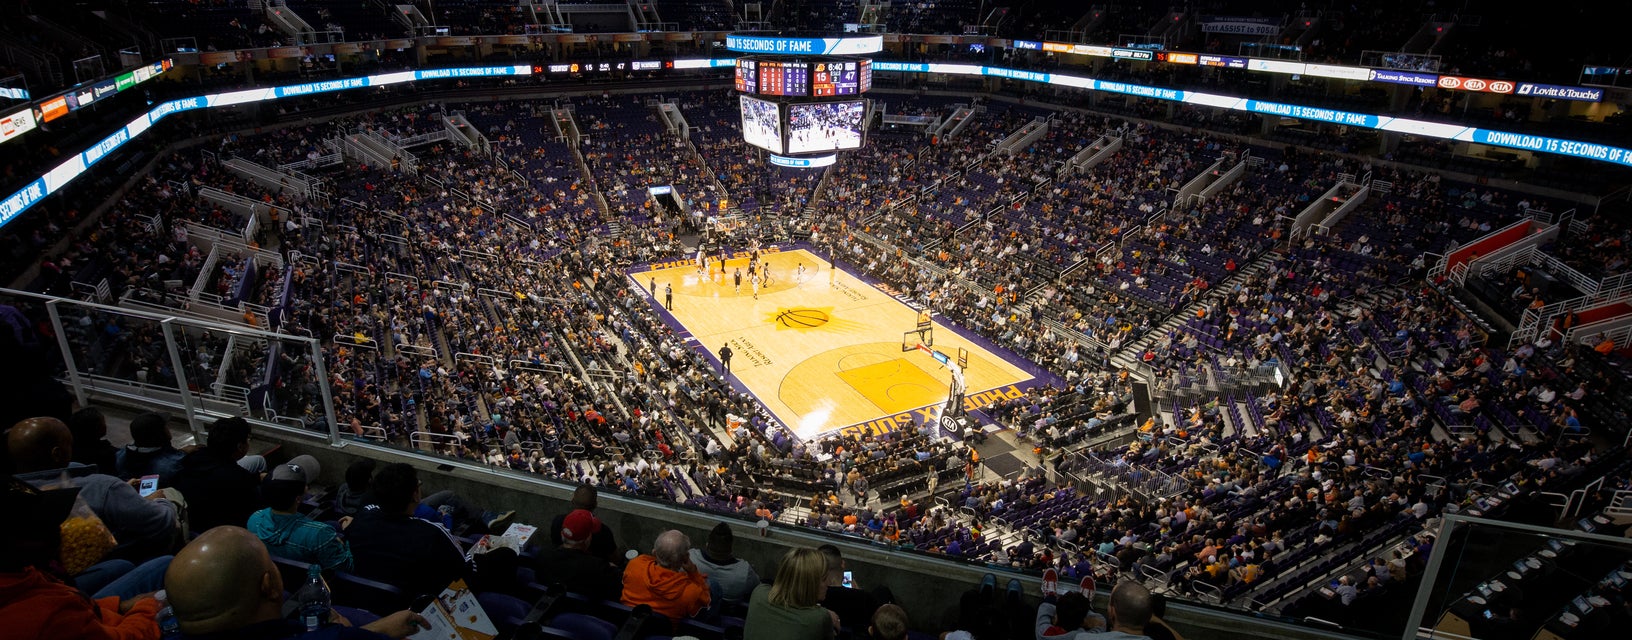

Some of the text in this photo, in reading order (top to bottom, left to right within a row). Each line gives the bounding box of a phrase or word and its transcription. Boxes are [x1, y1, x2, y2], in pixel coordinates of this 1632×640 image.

[1220, 25, 1245, 33] ASSIST
[736, 38, 742, 49] 15
[743, 39, 774, 51] SECONDS
[777, 40, 786, 51] OF
[789, 40, 811, 52] FAME
[422, 69, 450, 78] DOWNLOAD
[460, 67, 484, 76] SECONDS
[486, 67, 492, 75] OF
[493, 67, 507, 75] FAME
[881, 62, 901, 70] SECONDS
[909, 63, 921, 71] FAME
[816, 72, 827, 82] 15
[845, 71, 856, 81] 47
[1414, 76, 1435, 84] RESORT
[283, 85, 313, 96] DOWNLOAD
[320, 81, 344, 91] SECONDS
[344, 80, 351, 88] OF
[351, 78, 363, 87] FAME
[1100, 81, 1176, 99] DOWNLOAD 15 SECONDS OF FAME
[1533, 87, 1558, 96] Lovitt
[1567, 89, 1599, 100] Touché
[1255, 102, 1367, 125] DOWNLOAD 15 SECONDS OF FAME
[1487, 131, 1542, 149] DOWNLOAD
[1546, 137, 1558, 151] 15
[1560, 141, 1607, 159] SECONDS
[1609, 148, 1621, 161] OF
